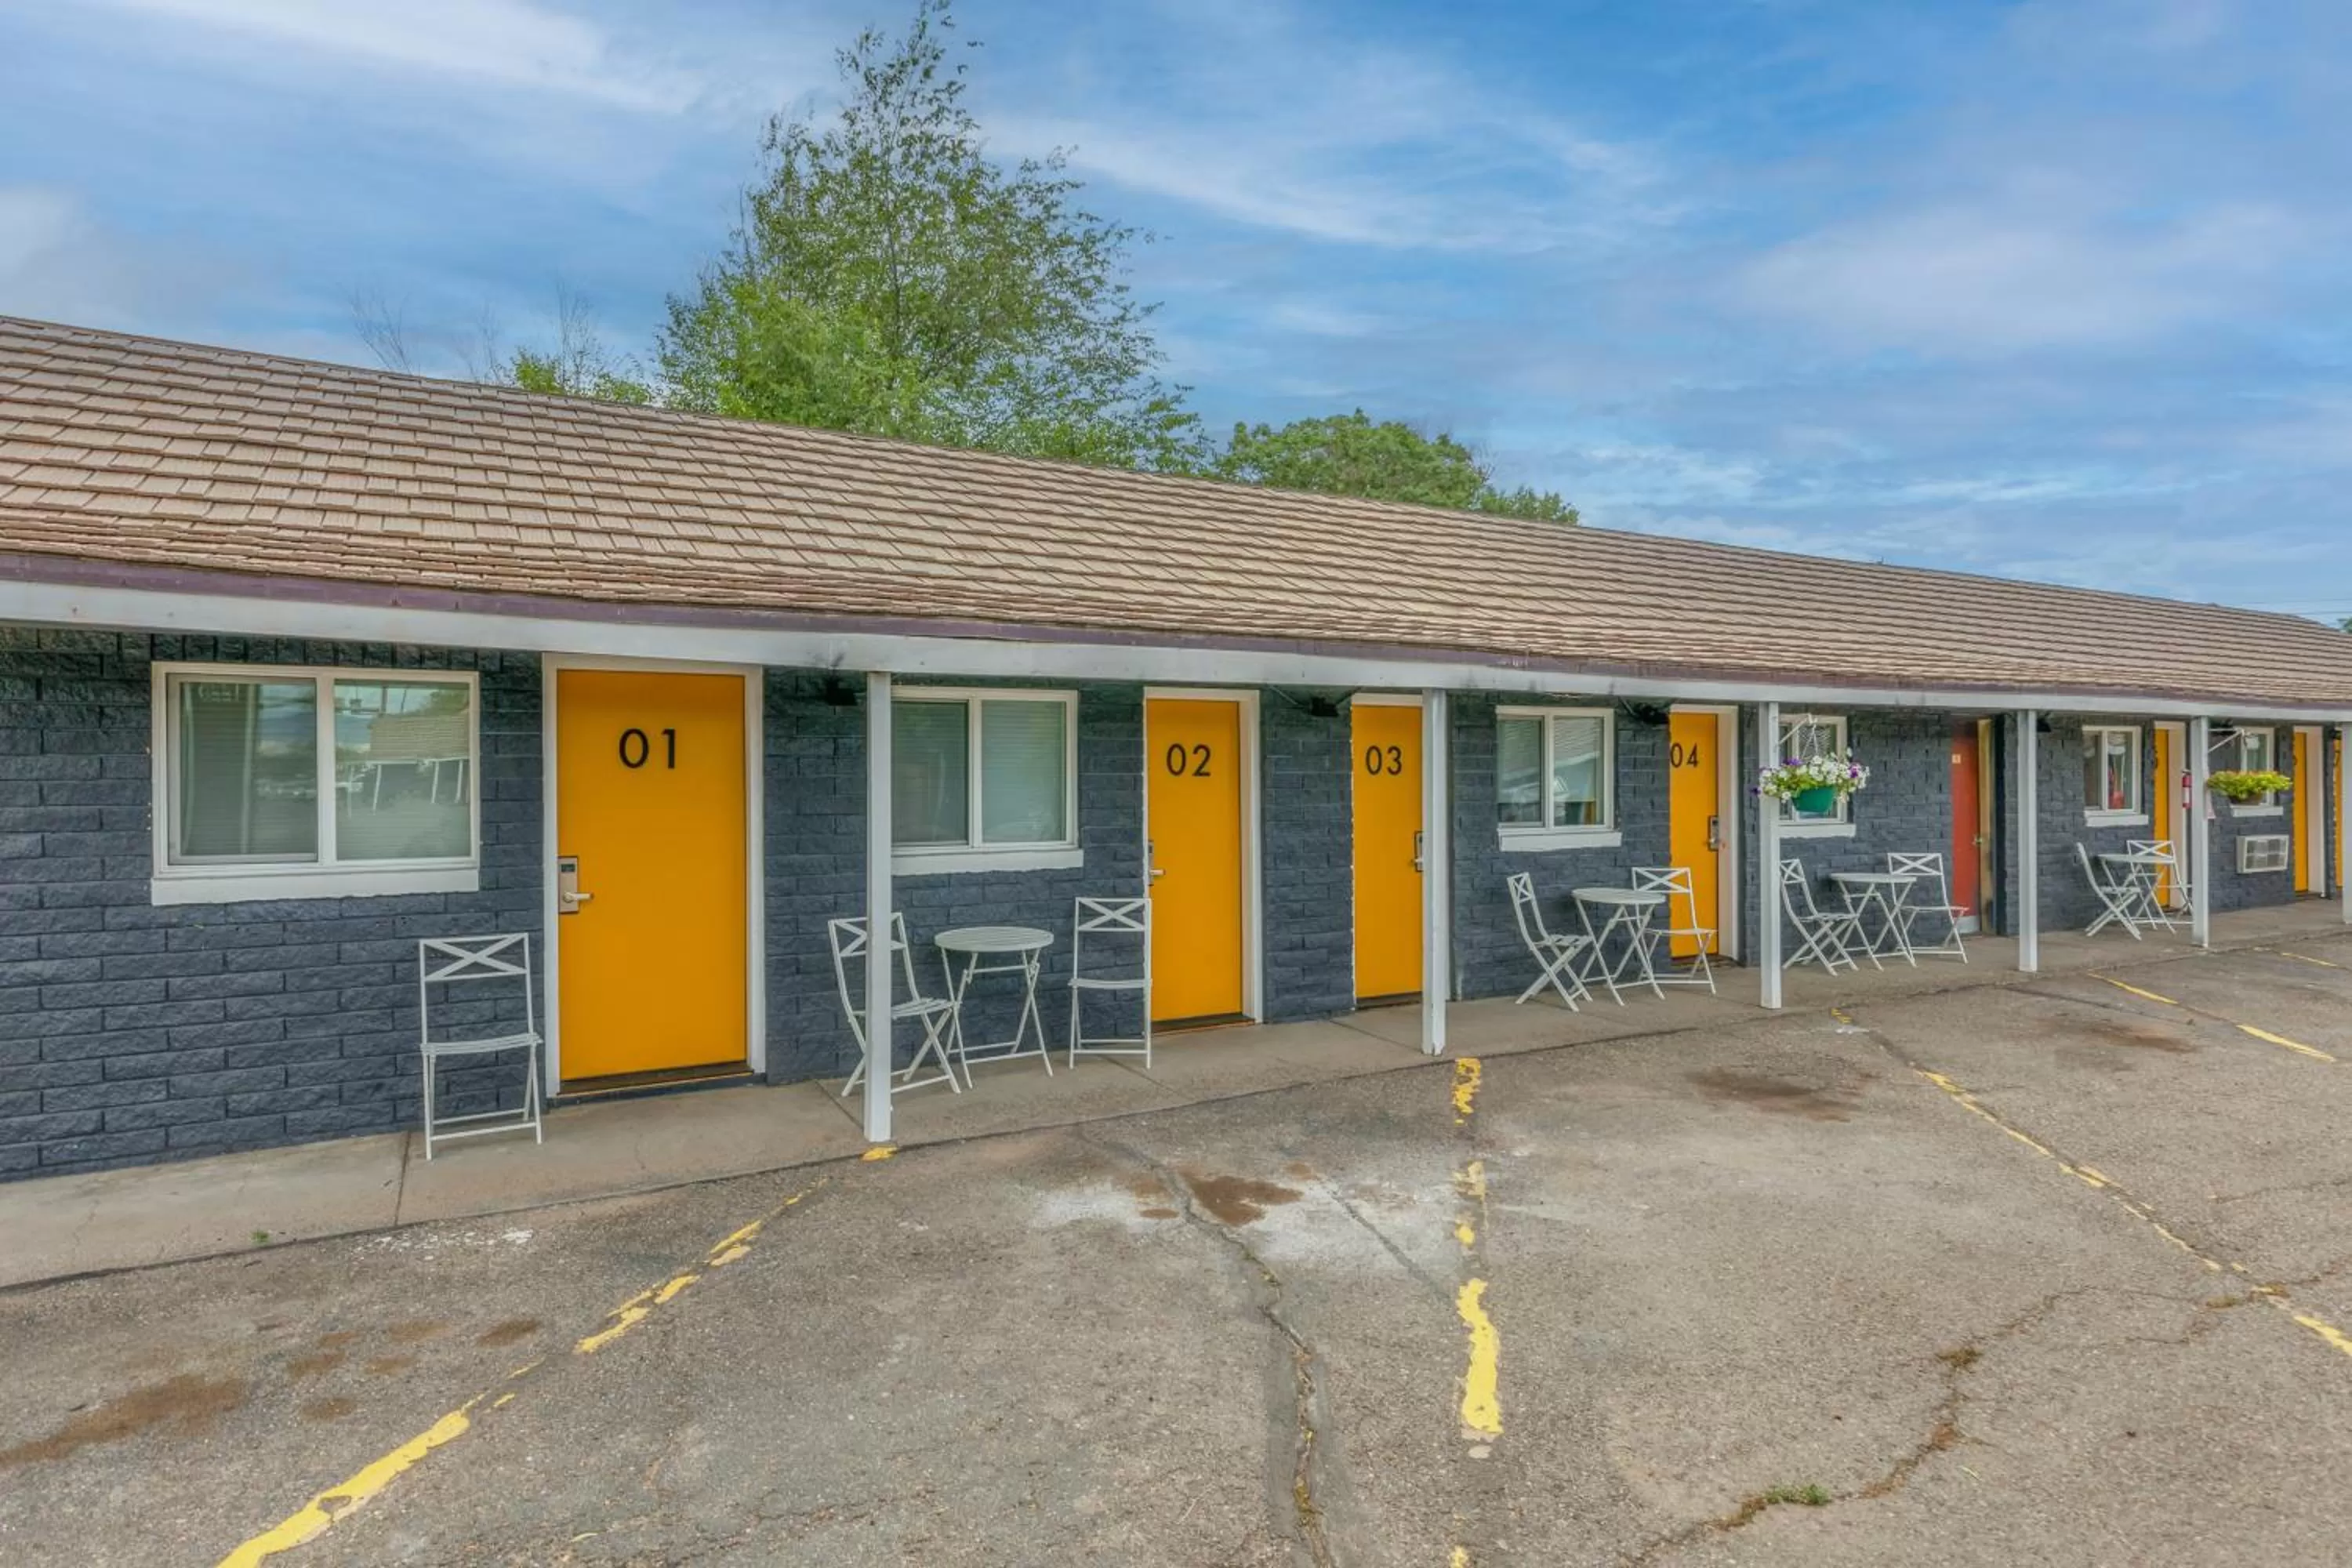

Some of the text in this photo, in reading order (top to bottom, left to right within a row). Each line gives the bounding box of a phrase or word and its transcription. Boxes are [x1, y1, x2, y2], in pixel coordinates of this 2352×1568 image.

[619, 728, 677, 769] 01
[1166, 743, 1211, 777] 02
[1365, 745, 1403, 776] 03
[1671, 742, 1700, 768] 04
